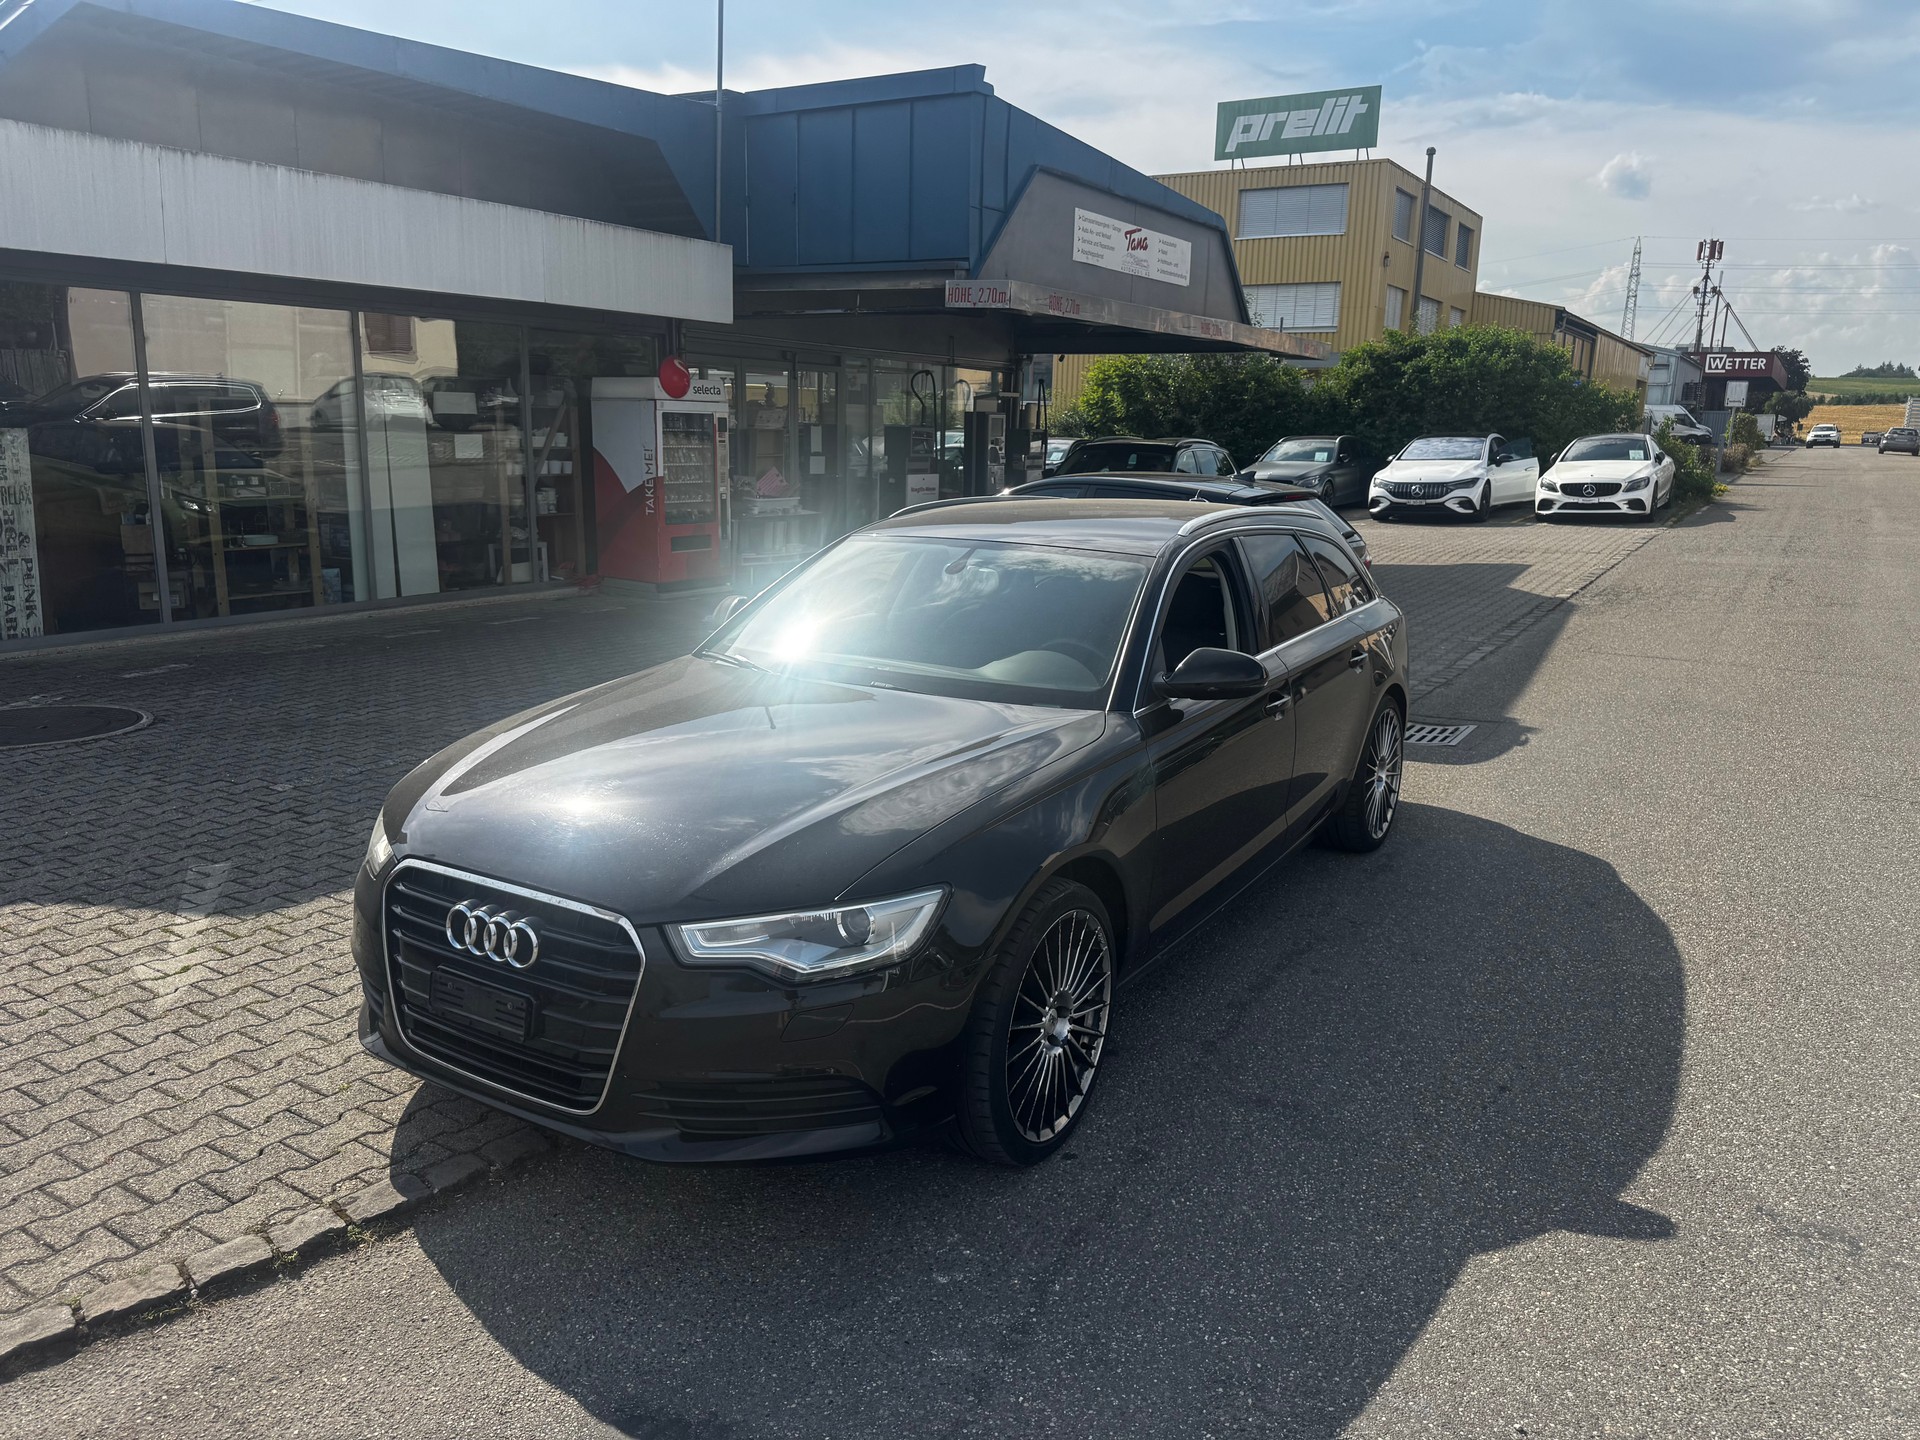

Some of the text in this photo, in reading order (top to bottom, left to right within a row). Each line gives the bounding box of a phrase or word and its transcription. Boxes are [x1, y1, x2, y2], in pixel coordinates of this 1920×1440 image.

[1224, 94, 1369, 153] prelit
[1124, 227, 1149, 252] Tana
[947, 284, 972, 303] HÖHE
[1710, 357, 1767, 370] WETTER
[692, 385, 721, 396] selecta
[644, 478, 655, 516] TAKE
[21, 557, 38, 620] PUNK
